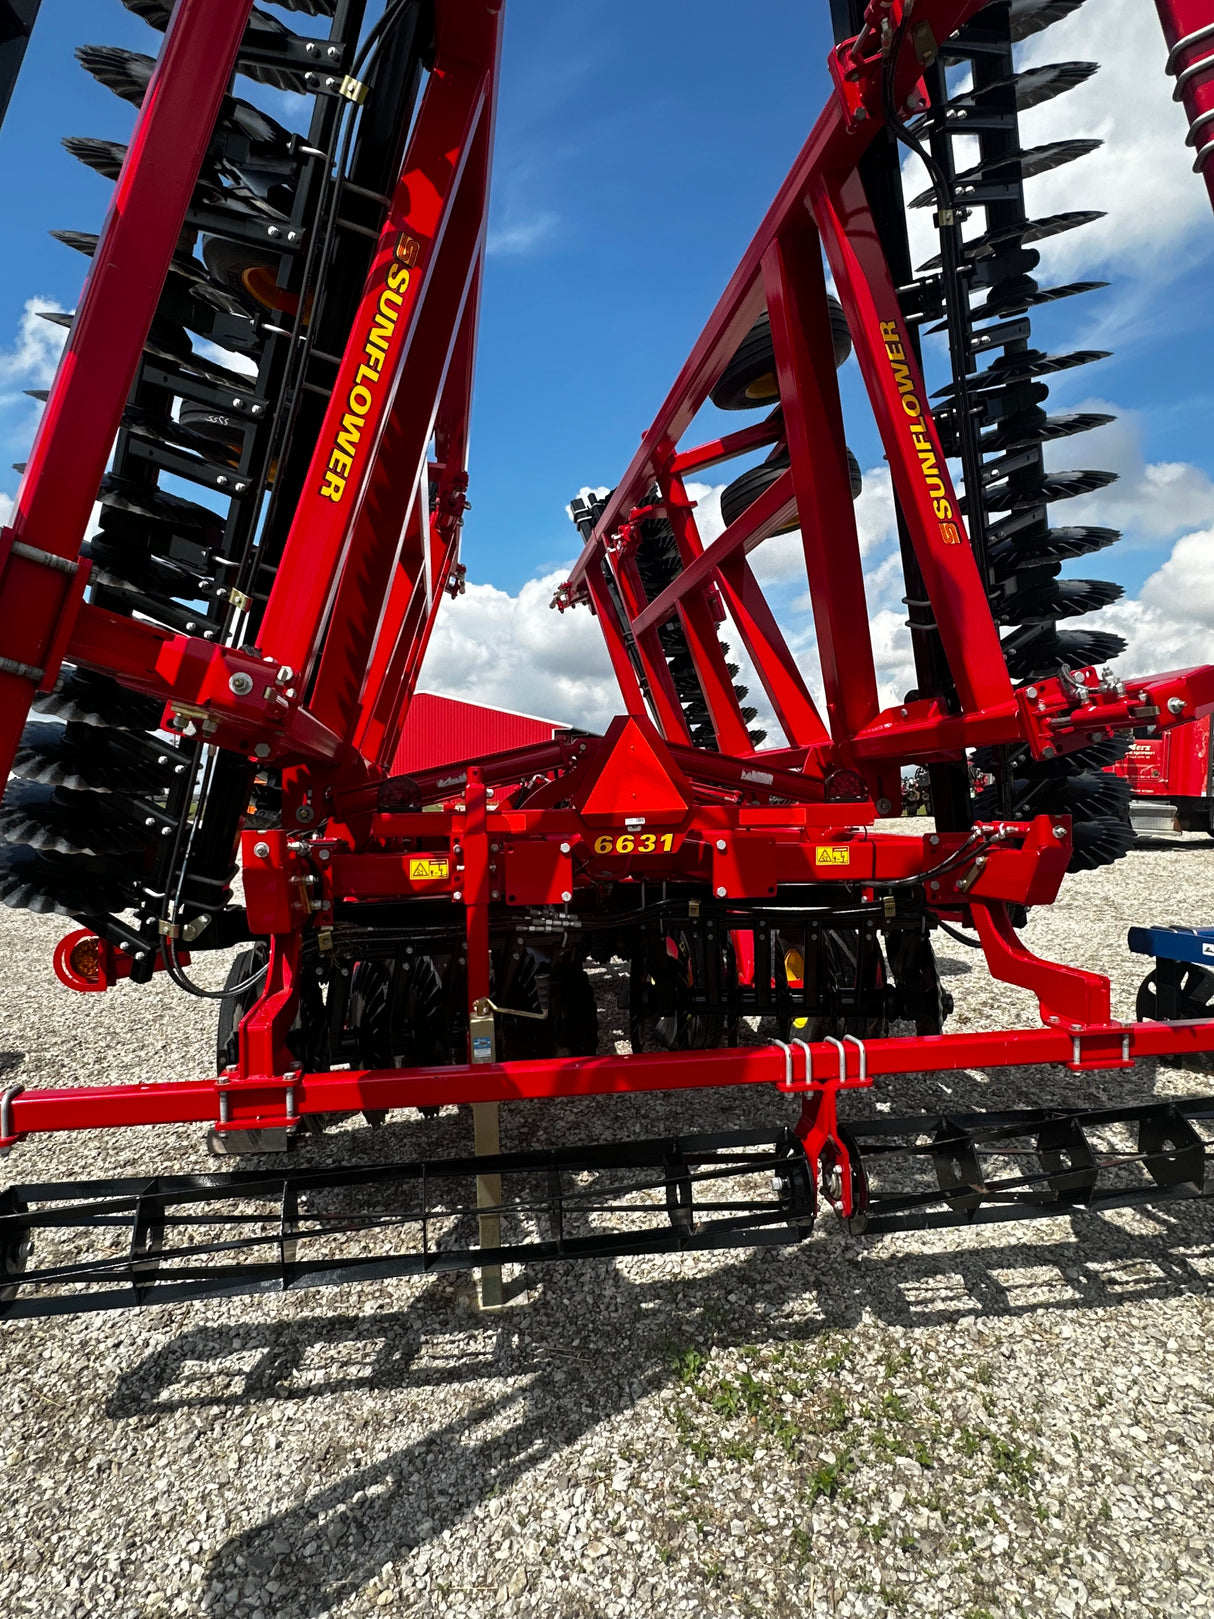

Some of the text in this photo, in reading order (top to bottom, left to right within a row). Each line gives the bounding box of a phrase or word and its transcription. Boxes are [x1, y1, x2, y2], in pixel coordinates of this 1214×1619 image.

[319, 262, 411, 503] SUNFLOWER
[879, 320, 953, 521] SUNFLOWER
[594, 833, 674, 855] 6631
